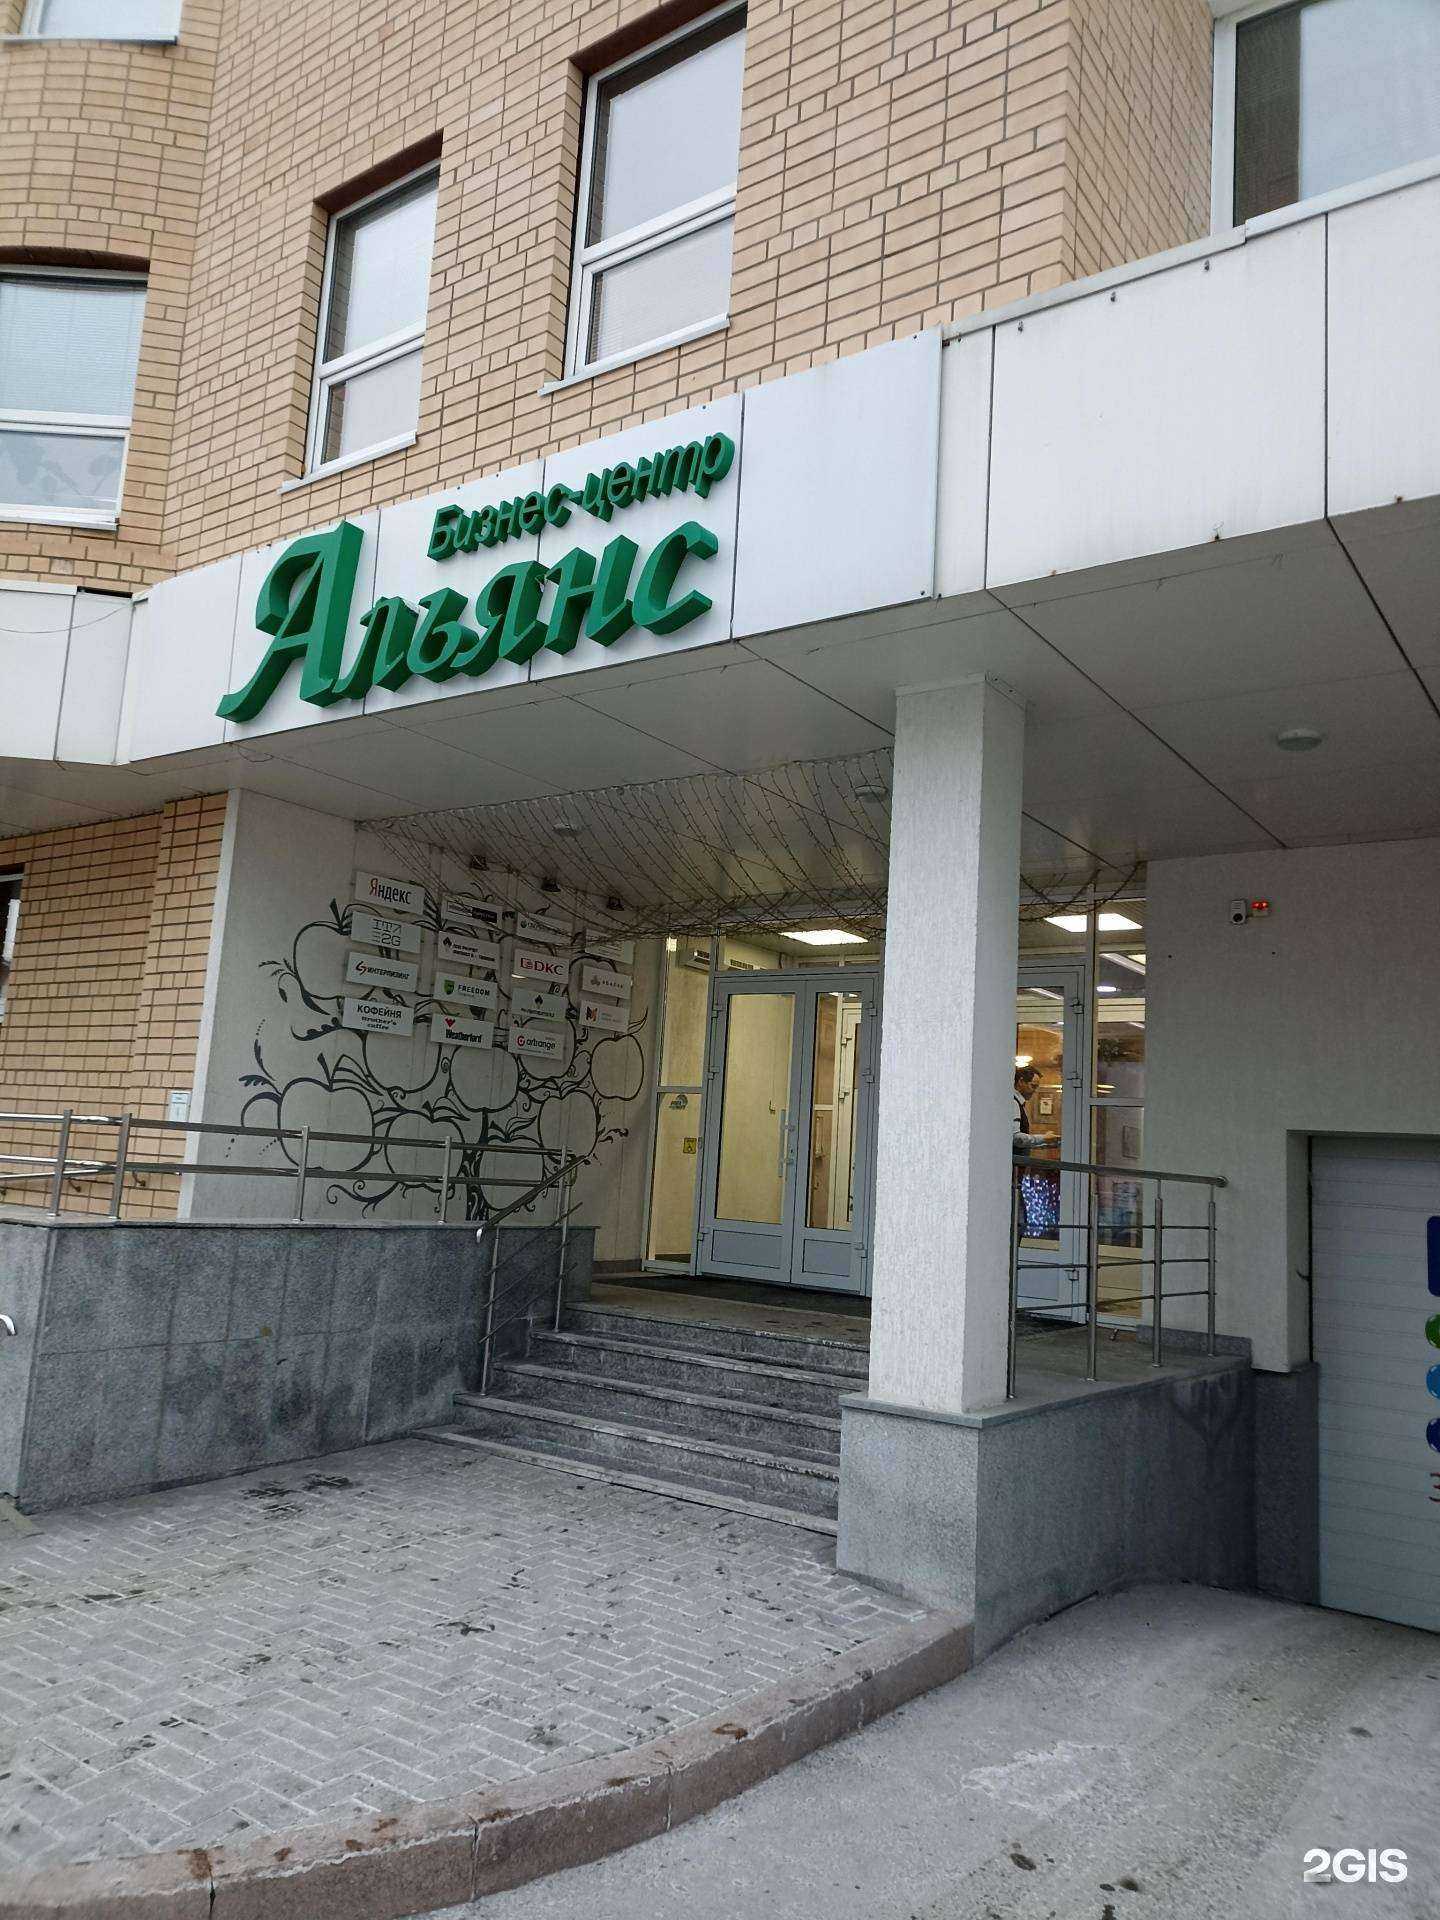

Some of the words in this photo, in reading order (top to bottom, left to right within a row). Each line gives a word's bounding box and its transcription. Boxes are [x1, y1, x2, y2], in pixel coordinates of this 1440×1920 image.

[427, 431, 735, 561] Бизнес-центр
[215, 520, 719, 724] Альянс
[369, 878, 412, 904] Яндекс
[457, 984, 491, 996] FREEDOM
[357, 1003, 402, 1018] КОФЕЙНЯ
[445, 1028, 482, 1043] Weatherford
